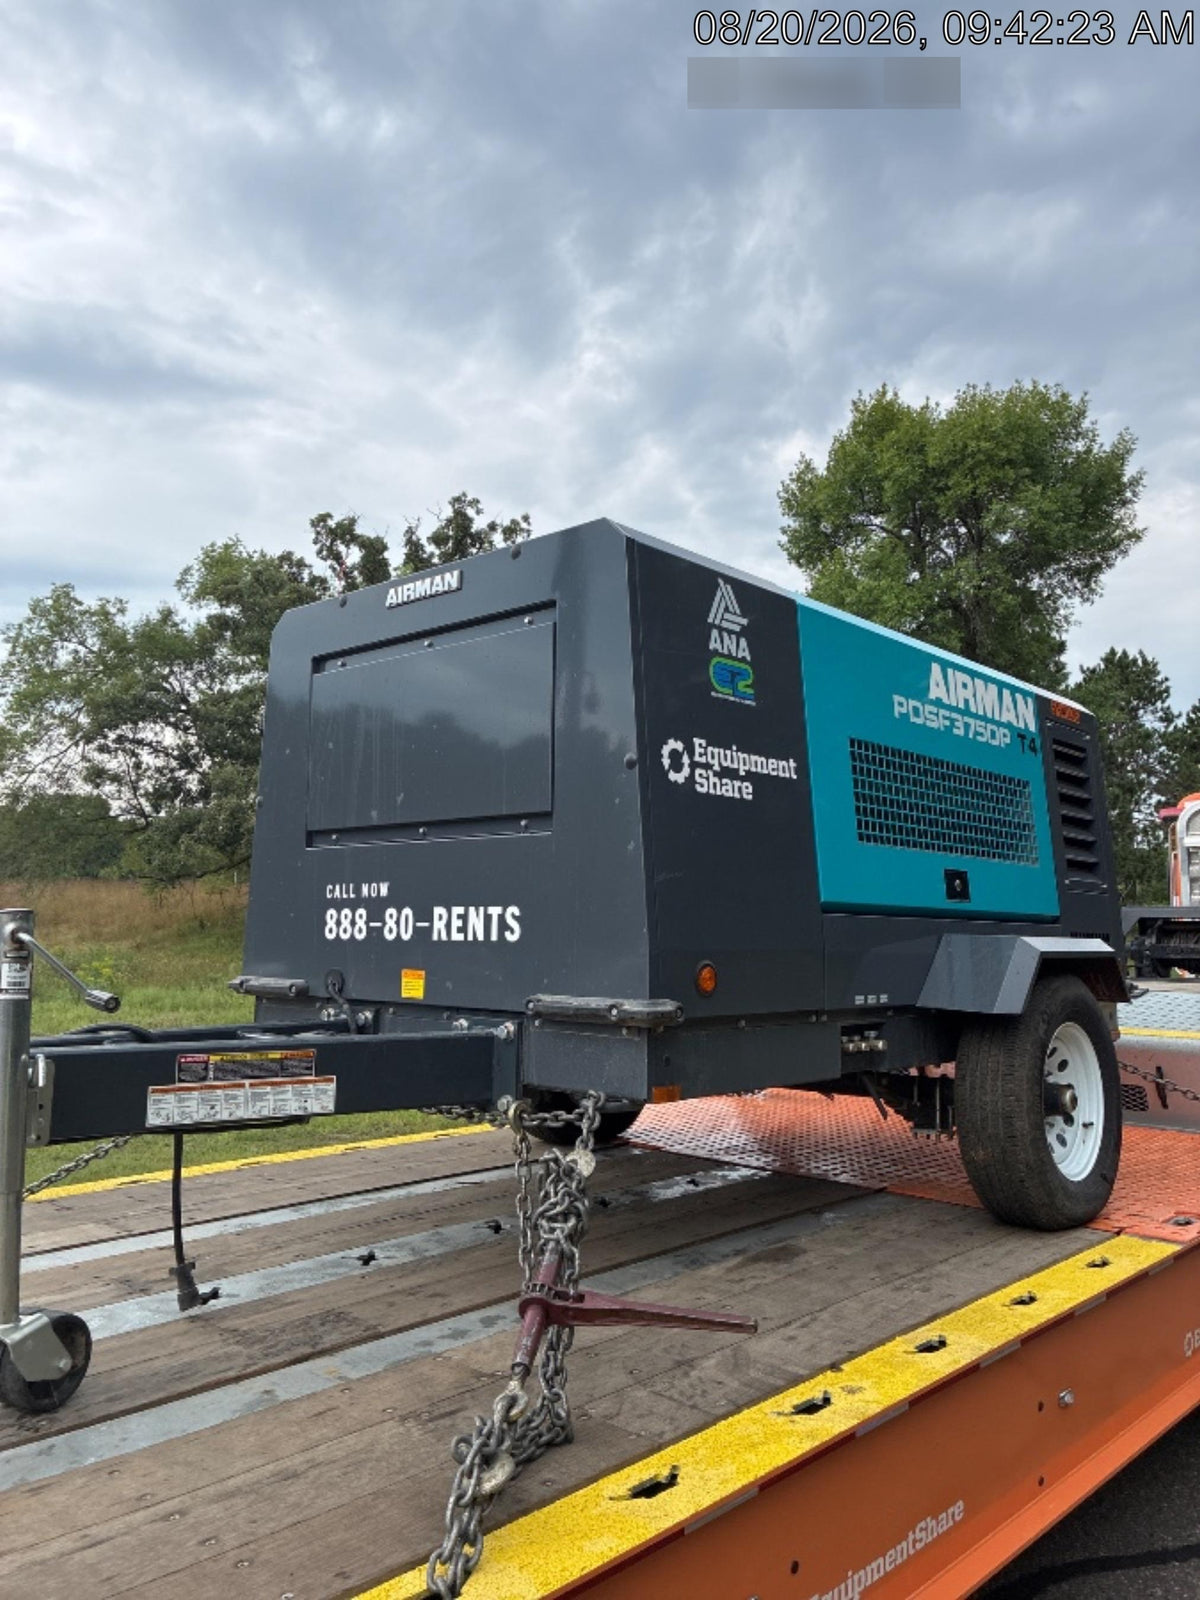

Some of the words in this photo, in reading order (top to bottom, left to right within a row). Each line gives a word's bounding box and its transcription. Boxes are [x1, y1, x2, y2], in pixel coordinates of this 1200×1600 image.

[384, 569, 461, 608] AIRMAN
[709, 628, 751, 662] ANA
[928, 662, 1036, 733] AIRMAN
[693, 737, 798, 780] Equipment
[1017, 732, 1038, 757] T4
[694, 768, 753, 801] Share
[326, 883, 356, 899] CALL
[361, 881, 390, 898] NOW
[324, 905, 522, 942] 888-80-RENTS
